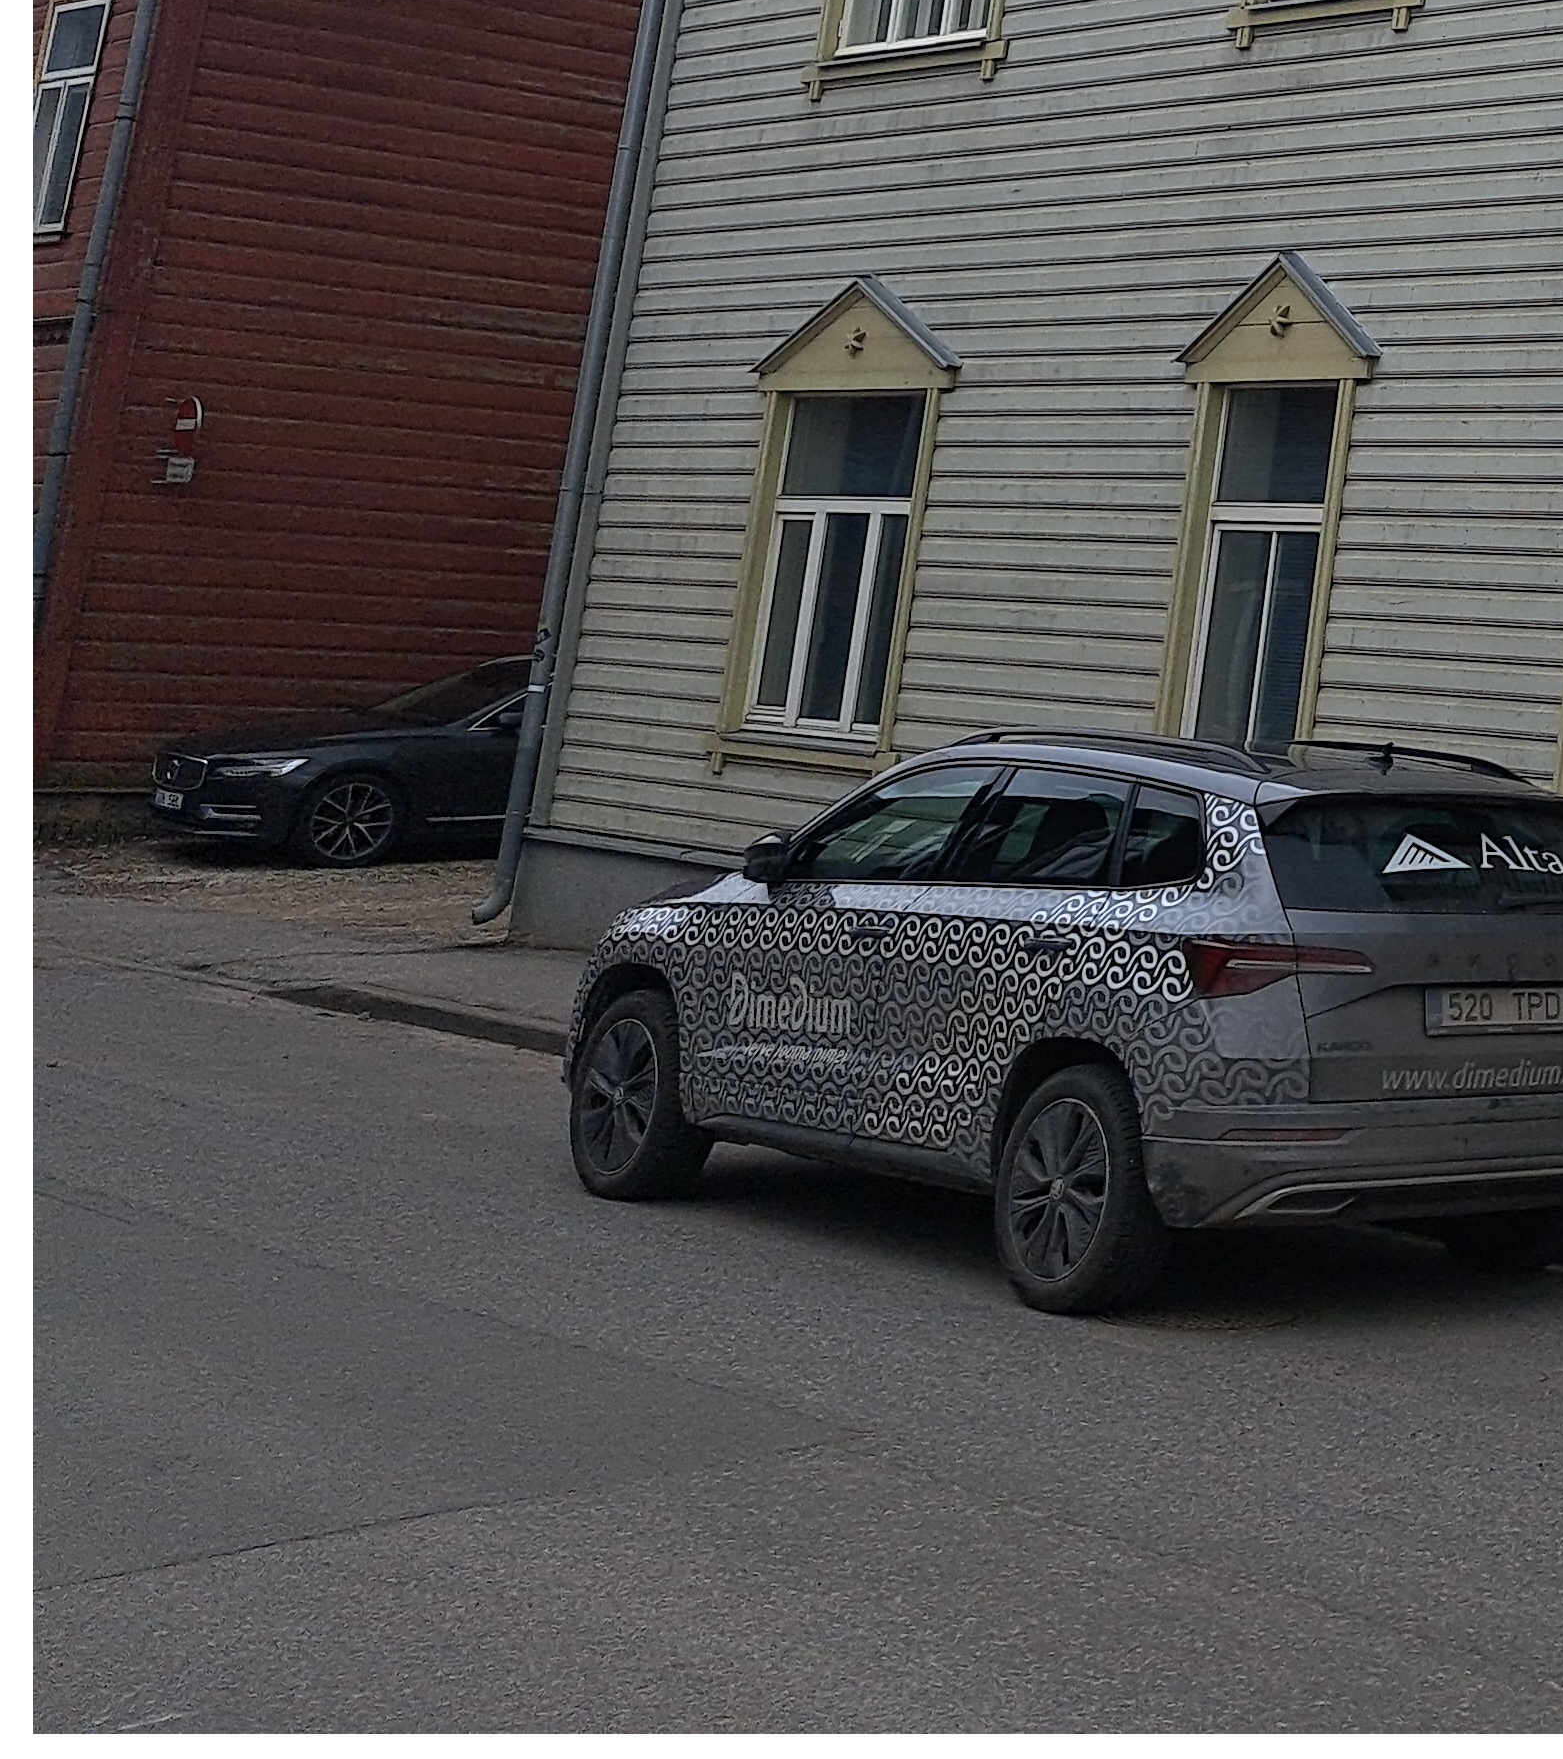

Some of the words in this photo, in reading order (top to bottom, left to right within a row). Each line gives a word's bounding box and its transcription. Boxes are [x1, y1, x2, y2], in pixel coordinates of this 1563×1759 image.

[729, 971, 851, 1037] Dimedium
[1448, 992, 1493, 1021] 520
[1512, 992, 1561, 1020] TPD
